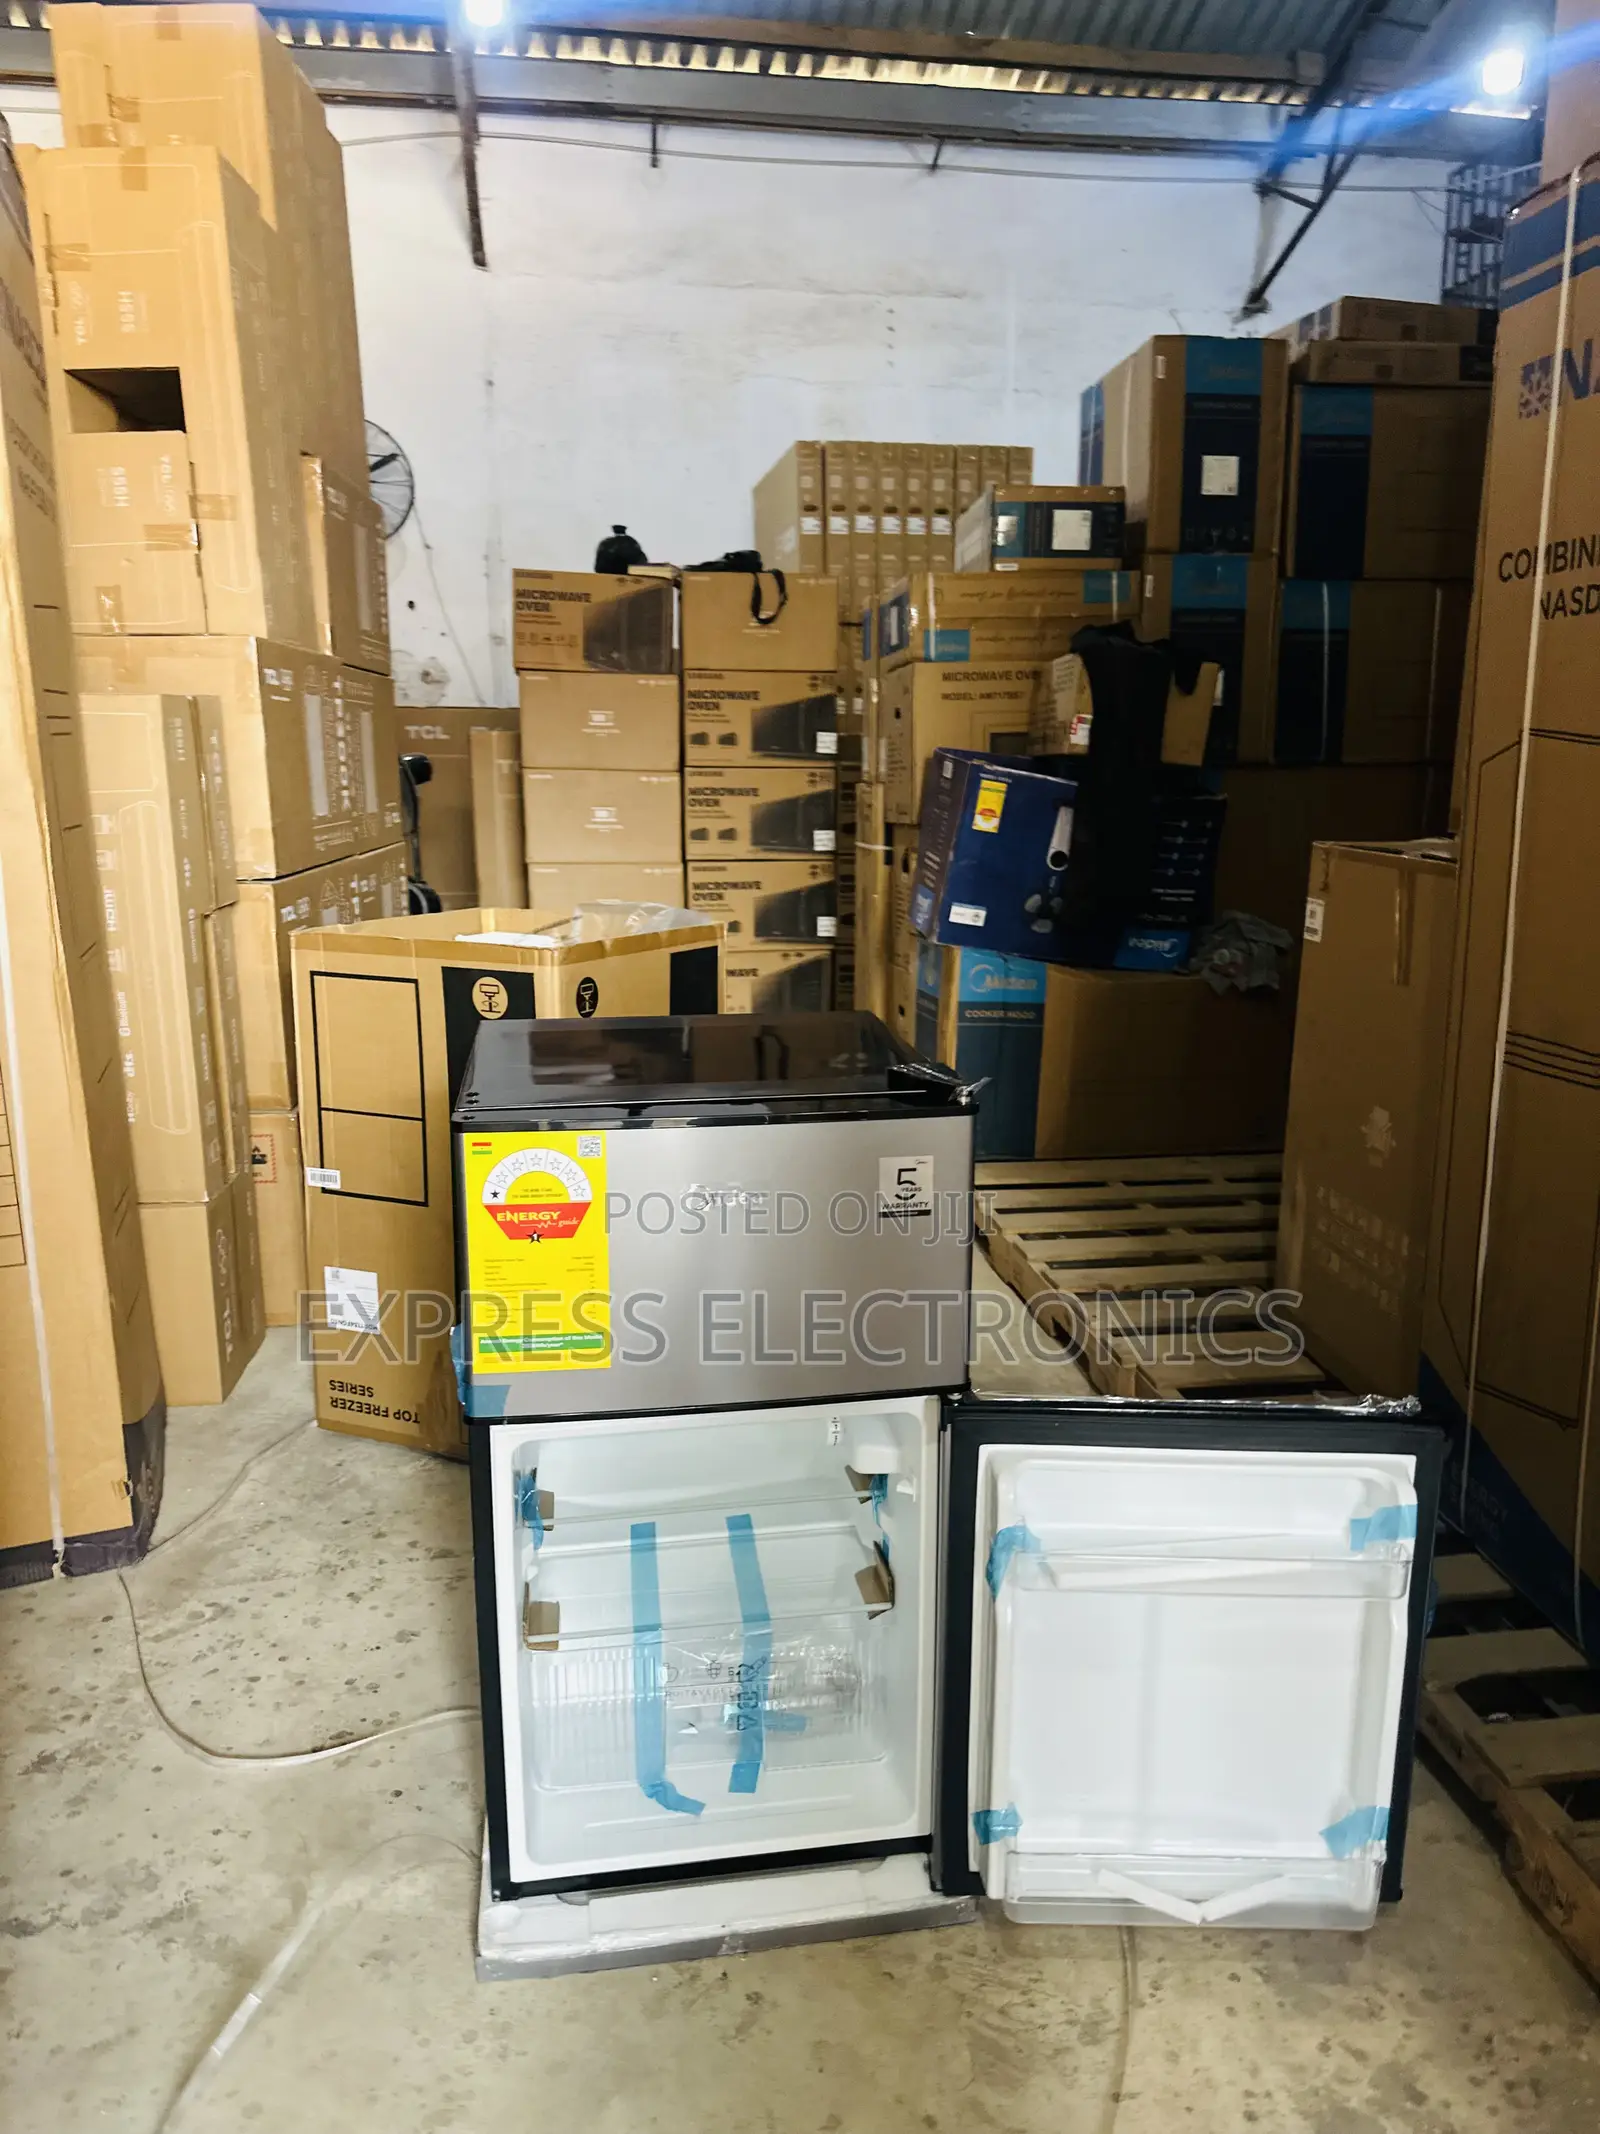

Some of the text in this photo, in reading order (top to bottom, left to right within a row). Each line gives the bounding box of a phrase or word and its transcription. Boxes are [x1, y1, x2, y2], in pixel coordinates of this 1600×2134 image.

[1563, 339, 1600, 400] N
[1498, 534, 1600, 583] COMBIN
[515, 588, 592, 603] MICROWAVE
[515, 601, 551, 612] OVEN
[942, 670, 1012, 682] MICROWAVE
[687, 690, 760, 701] MICROWAVE
[687, 701, 720, 711] OVEN
[404, 725, 450, 740] TCL
[688, 787, 760, 797] MICROWAVE
[688, 798, 720, 808] OVEN
[692, 880, 762, 891] MICROWAVE
[692, 892, 724, 902] OVEN
[964, 1010, 1005, 1019] COOKER
[894, 1167, 917, 1201] 5
[882, 1201, 930, 1210] WARRANTY
[496, 1210, 580, 1228] ENERGY guide
[329, 1379, 374, 1398] SERIES
[330, 1396, 421, 1424] TOP FREEZER
